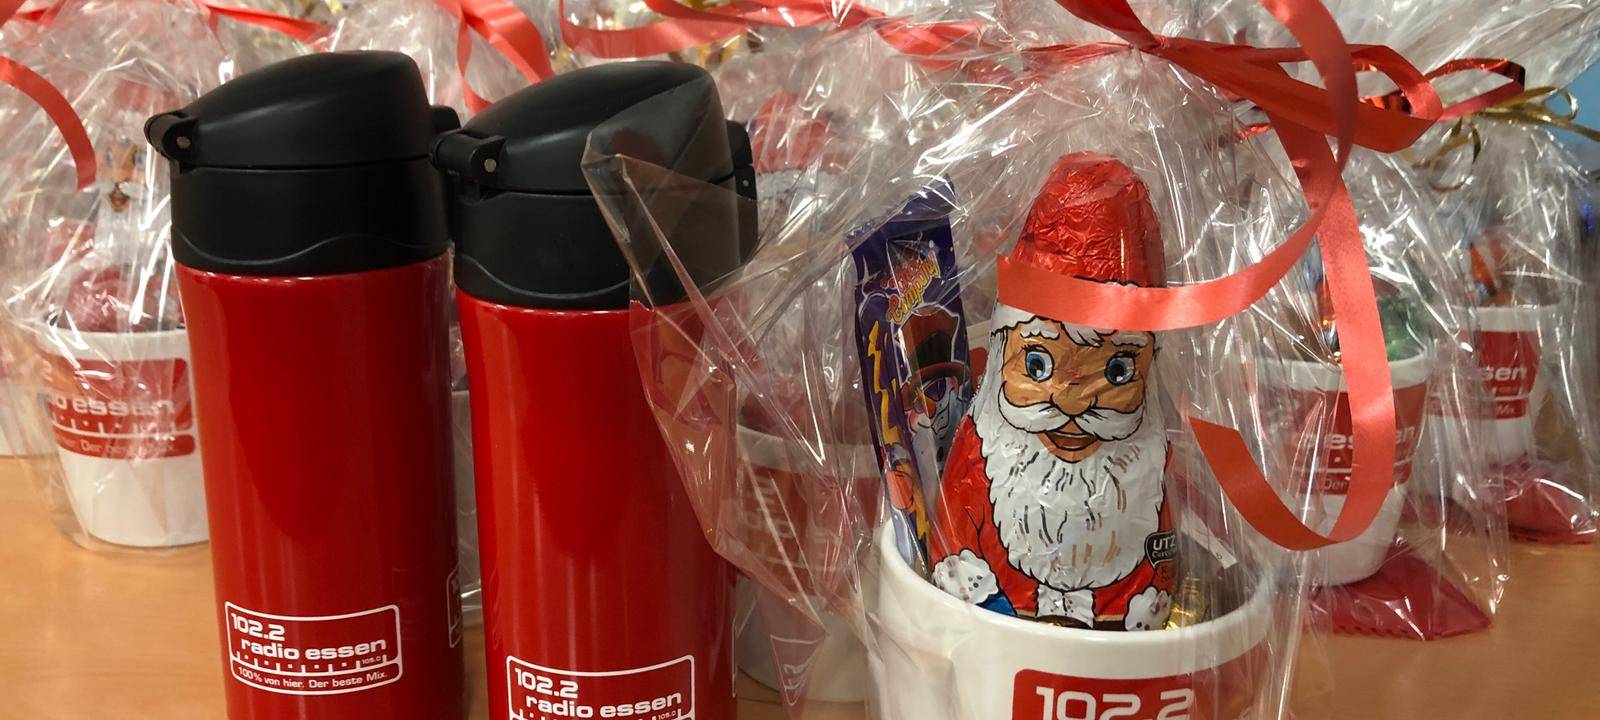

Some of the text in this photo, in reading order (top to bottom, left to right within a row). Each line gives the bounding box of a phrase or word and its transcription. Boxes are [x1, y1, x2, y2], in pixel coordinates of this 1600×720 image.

[1152, 534, 1176, 551] UTZ
[231, 612, 286, 642] 102.2
[241, 638, 387, 660] radio essen
[238, 666, 389, 688] 100% von hier. Der beste Mix.
[514, 667, 579, 699] 102.2
[526, 692, 682, 718] radio essen
[1036, 686, 1195, 720] 1022
